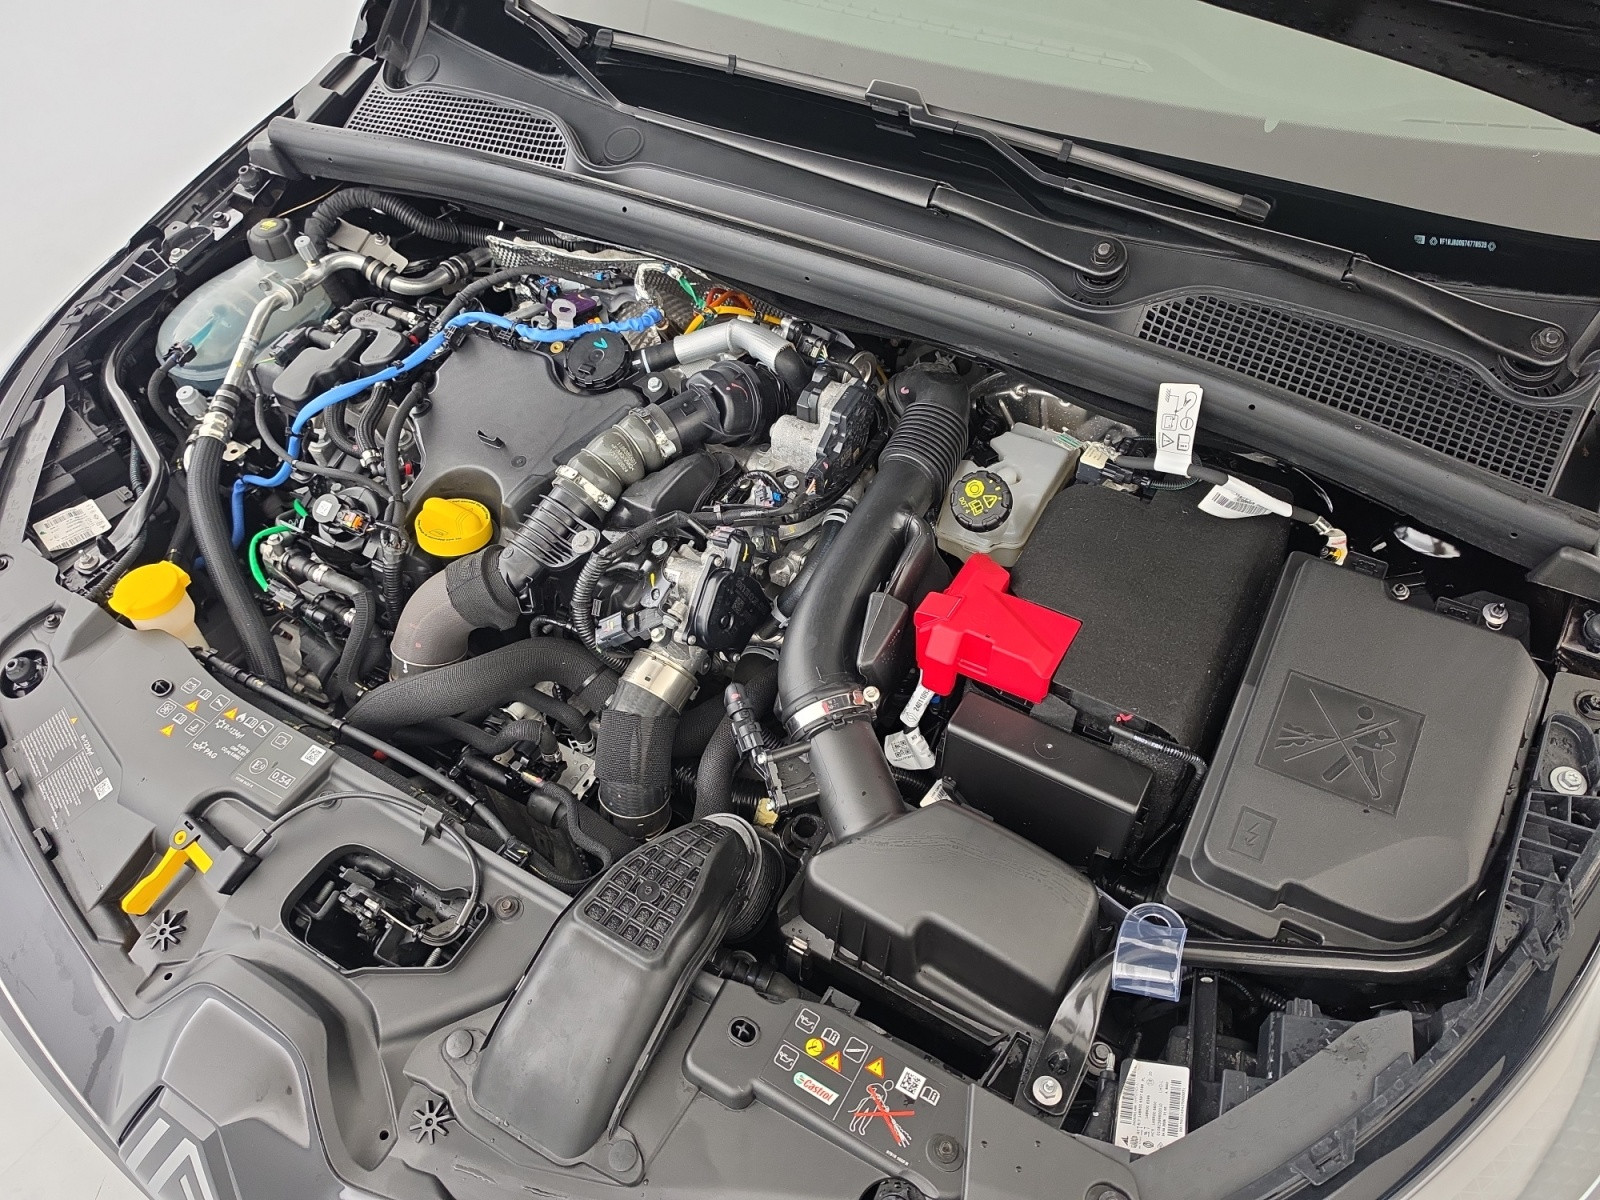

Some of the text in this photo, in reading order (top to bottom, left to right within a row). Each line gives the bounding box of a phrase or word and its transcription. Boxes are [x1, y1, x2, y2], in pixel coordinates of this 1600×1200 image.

[204, 747, 217, 759] PAG
[272, 771, 290, 785] 0,54
[803, 1079, 832, 1101] Castrol
